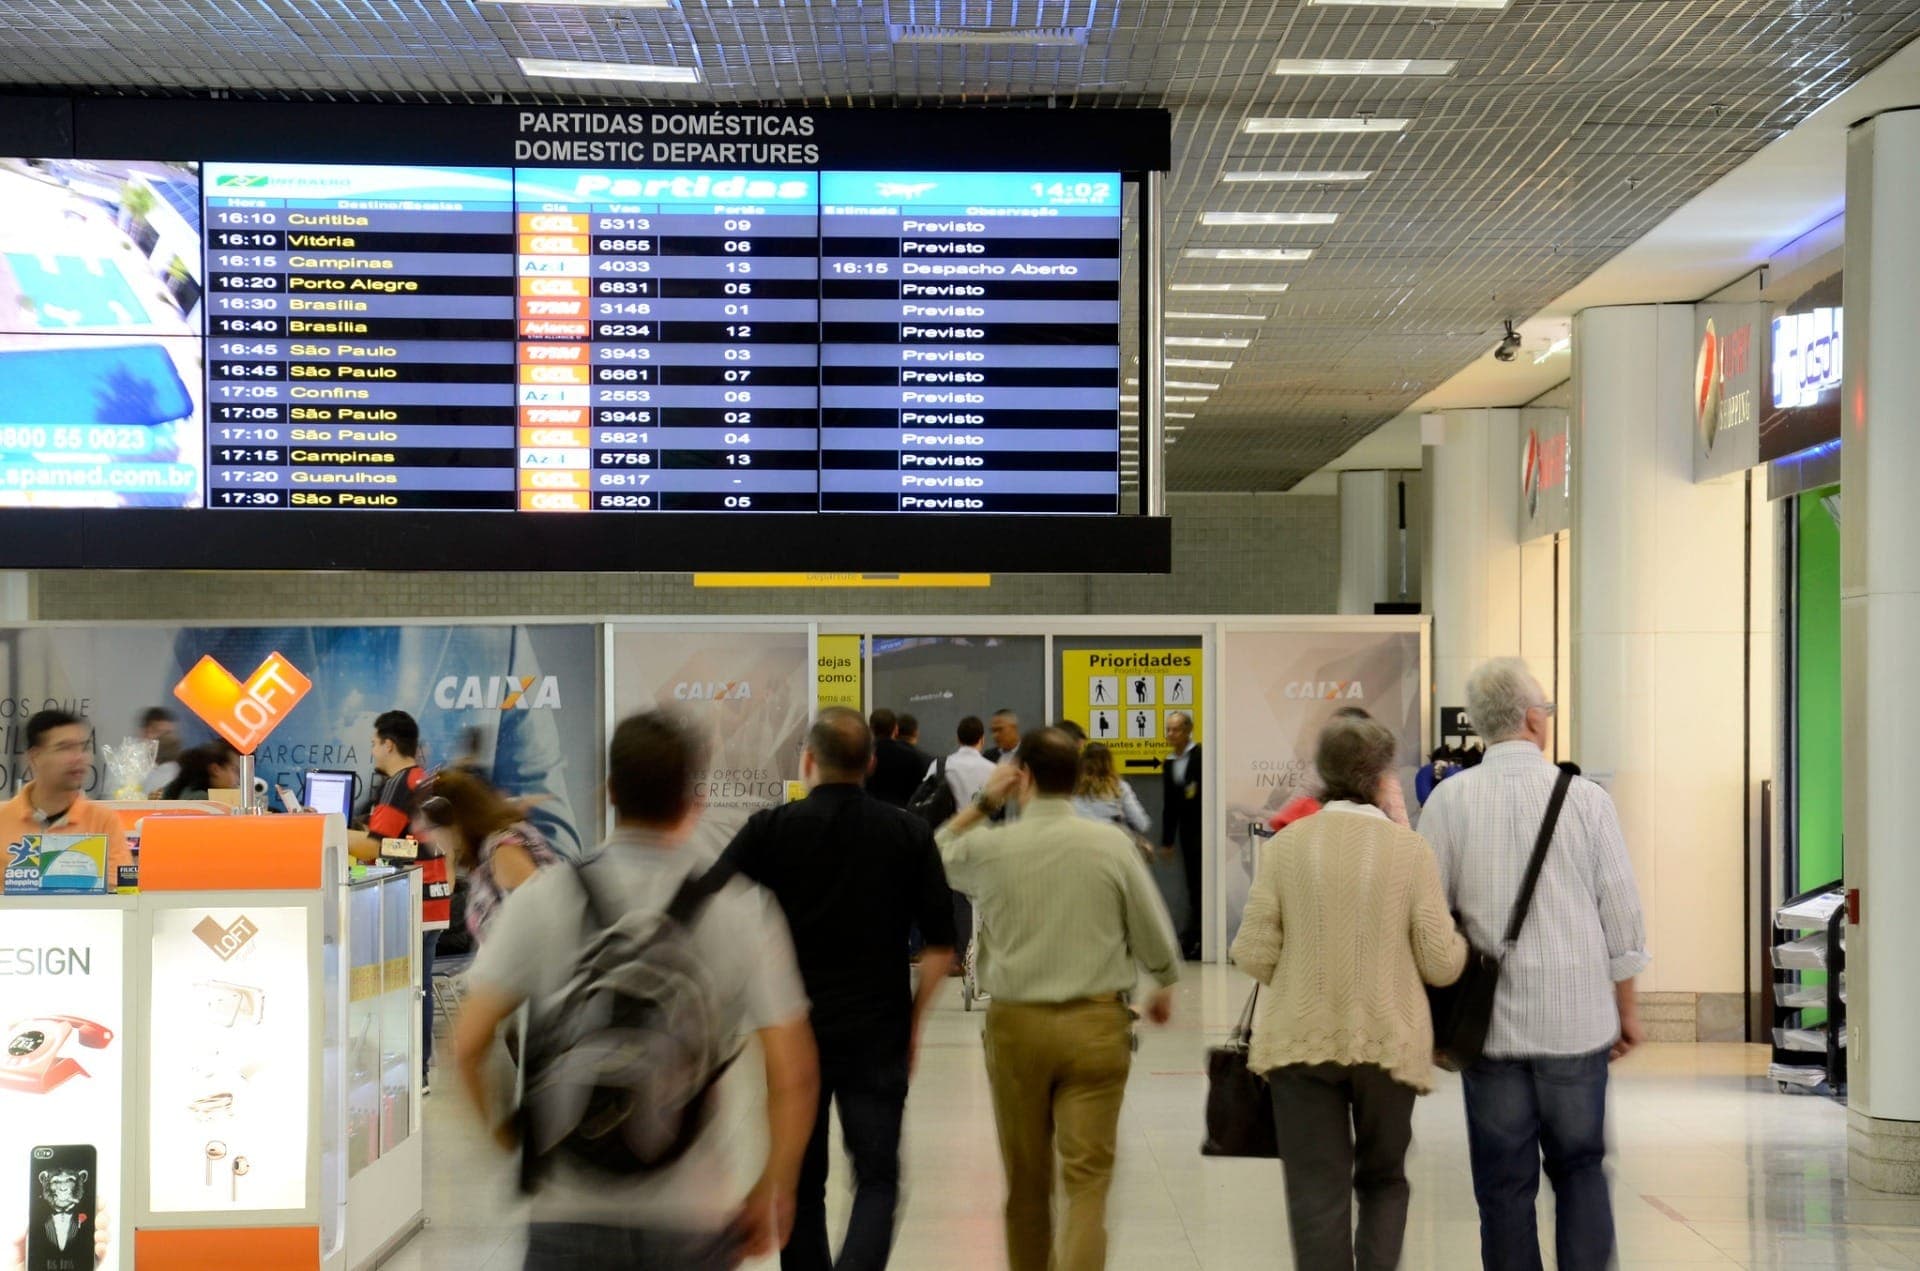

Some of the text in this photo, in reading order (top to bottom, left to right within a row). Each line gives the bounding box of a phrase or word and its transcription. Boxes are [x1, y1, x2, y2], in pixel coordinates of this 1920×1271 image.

[520, 111, 815, 136] PARTIDAS DOMÉSTICAS
[515, 140, 820, 163] DOMESTIC DEPARTURES
[574, 175, 809, 198] Partidas
[1031, 182, 1110, 197] 14:02
[218, 212, 276, 225] 16:10
[287, 213, 369, 226] Curitiba
[599, 218, 650, 230] 5313
[724, 219, 752, 232] 09
[902, 220, 986, 233] Previsto
[219, 233, 276, 246] 16:10
[288, 235, 355, 247] Vitória
[599, 239, 650, 251] 6855
[724, 241, 751, 252] 06
[903, 241, 985, 253] Previsto
[218, 255, 1078, 277] 16:15 Campinas Azl 4033 13 16:15 Despacho Aberto
[219, 276, 277, 289] 16:20
[289, 277, 346, 290] Porto
[350, 278, 418, 293] Alegre
[599, 281, 647, 293] 6831
[724, 283, 751, 294] 05
[903, 283, 985, 296] Previsto
[219, 297, 278, 310] 16:30
[289, 298, 368, 312] Brasília
[599, 302, 651, 315] 3148
[724, 303, 749, 316] 01
[902, 304, 985, 317] Previsto
[220, 320, 277, 332] 16:40
[290, 320, 367, 333] Brasília
[599, 324, 650, 336] 6234
[726, 326, 751, 337] 12
[903, 326, 985, 338] Previsto
[220, 343, 278, 356] 16:45
[289, 344, 331, 356] São
[337, 345, 397, 357] Paulo
[724, 348, 751, 361] 03
[902, 349, 985, 362] Previsto
[220, 365, 278, 376] 16:45
[290, 365, 331, 377] São
[338, 366, 397, 378] Paulo
[599, 369, 647, 380] 6661
[724, 370, 751, 381] 07
[902, 371, 985, 382] Previsto
[220, 385, 985, 404] 17:05 Confins Azl 2553 06 Previsto
[221, 407, 278, 419] 17:05
[290, 407, 332, 419] São
[338, 408, 397, 420] Paulo
[600, 411, 651, 423] 3945
[724, 412, 751, 423] 02
[902, 412, 984, 424] Previsto
[53, 428, 82, 448] 55
[88, 428, 146, 449] 0023
[220, 428, 279, 441] 17:10
[290, 428, 332, 441] São
[338, 429, 398, 442] Paulo
[600, 431, 648, 444] 5821
[724, 432, 751, 445] 04
[901, 433, 985, 446] Previsto
[221, 449, 984, 466] 17:15 Campinas Azl 5758 13 Previsto
[221, 470, 279, 483] 17:20
[290, 471, 398, 484] Guarulhos
[599, 473, 651, 486] 6817
[901, 475, 984, 487] Previsto
[222, 492, 279, 504] 17:30
[291, 493, 332, 505] São
[339, 493, 398, 505] Paulo
[600, 495, 651, 507] 5820
[724, 496, 751, 508] 05
[902, 496, 983, 508] Previsto
[818, 656, 852, 669] dejas
[1090, 653, 1192, 667] Prioridades
[818, 674, 857, 683] como:
[433, 675, 562, 710] CAIXA
[673, 681, 750, 700] CAIXA
[1284, 680, 1365, 700] CAIXA
[219, 662, 296, 746] LOFT
[256, 744, 358, 765] ARCERIA
[693, 778, 785, 798] CRÉDITO
[1256, 773, 1304, 787] INVE
[5, 868, 40, 878] aero
[5, 879, 40, 888] shopping
[214, 919, 252, 958] LOFT
